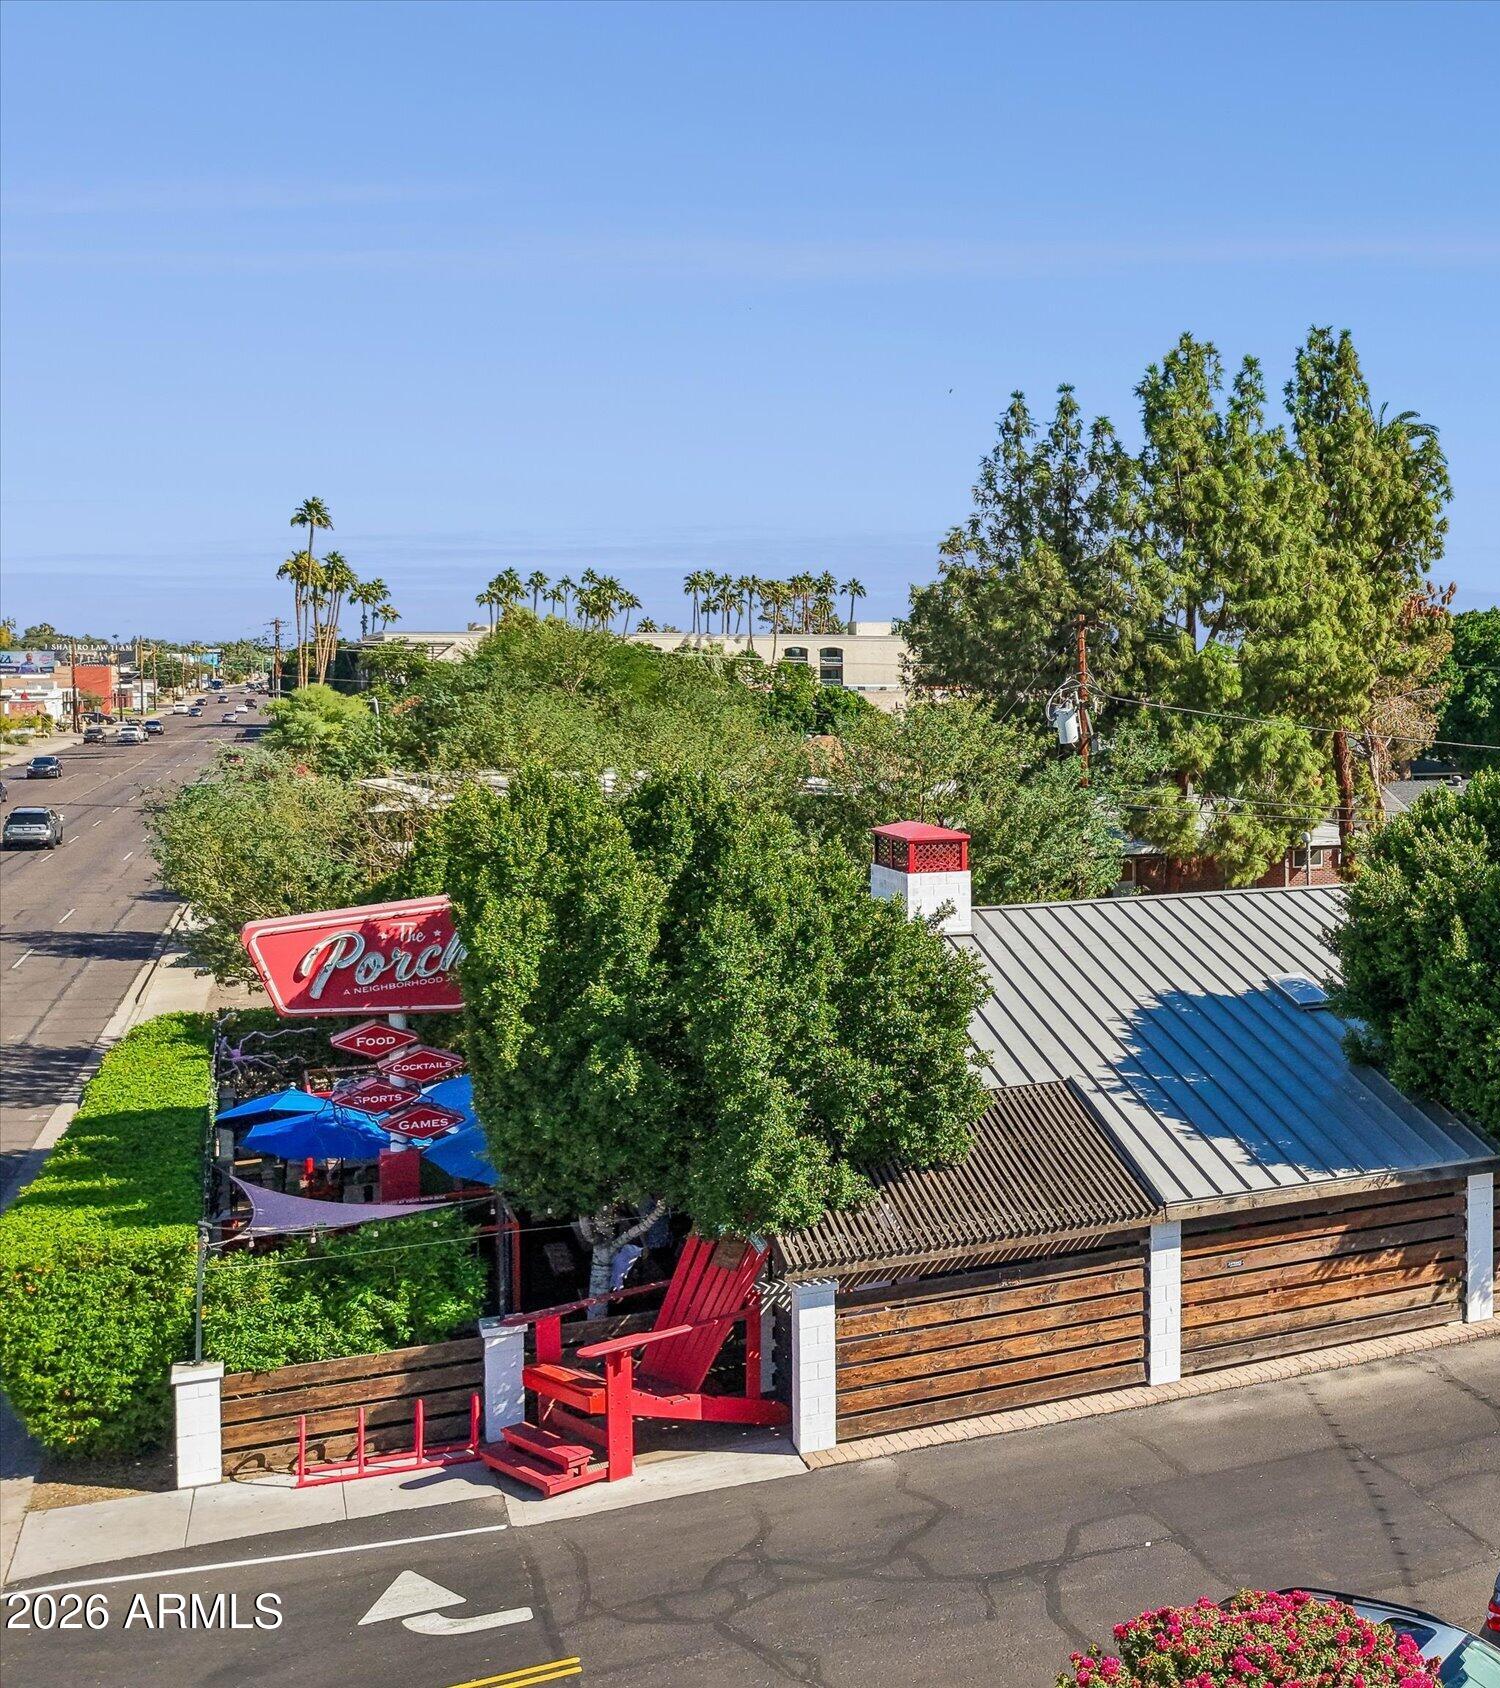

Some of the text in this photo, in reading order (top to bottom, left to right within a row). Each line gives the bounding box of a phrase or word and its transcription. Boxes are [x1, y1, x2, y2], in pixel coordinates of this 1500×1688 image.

[51, 643, 88, 651] SHARO
[390, 922, 426, 942] The
[301, 930, 469, 1000] Porch
[353, 976, 444, 995] NEIGHBORHOOD
[356, 1036, 396, 1047] FOOD
[392, 1061, 452, 1072] COCKTAILS
[353, 1094, 403, 1105] SPORTS
[398, 1118, 449, 1131] GAMES
